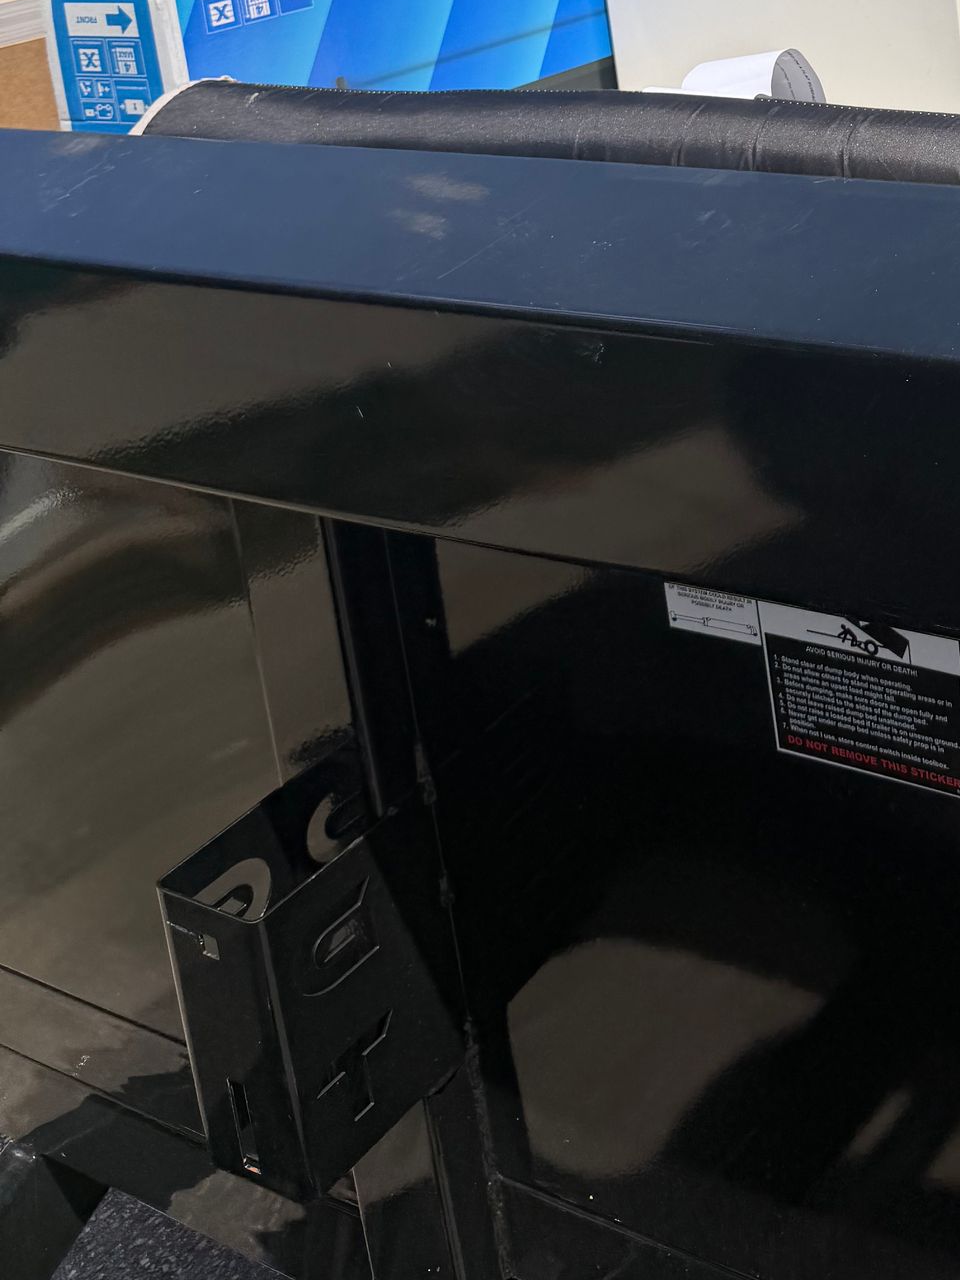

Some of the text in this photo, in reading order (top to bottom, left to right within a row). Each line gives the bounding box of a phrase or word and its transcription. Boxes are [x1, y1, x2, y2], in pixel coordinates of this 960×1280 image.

[75, 16, 98, 24] FRONT
[805, 645, 918, 676] AVOID SERIOUS INJURY OR DEATH!
[787, 734, 960, 787] DO NOT REMOVE THIS STICKER
